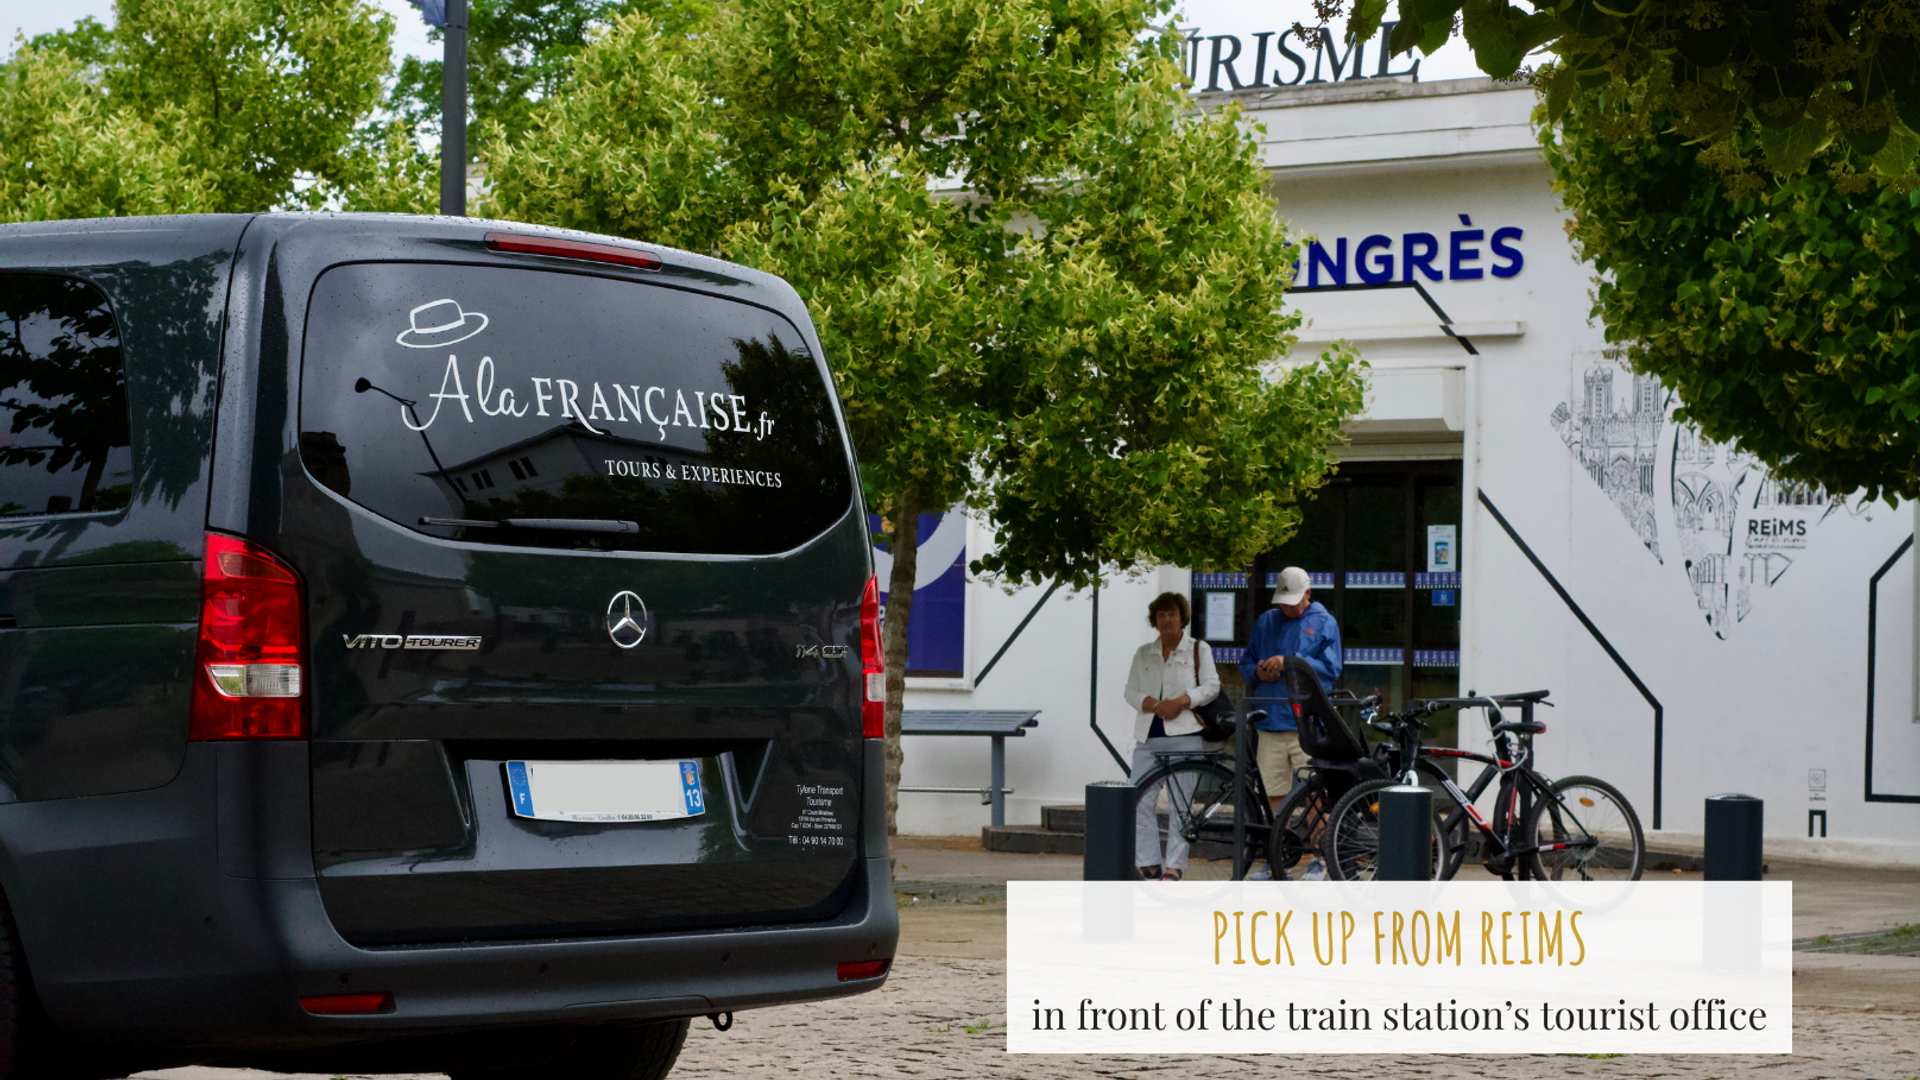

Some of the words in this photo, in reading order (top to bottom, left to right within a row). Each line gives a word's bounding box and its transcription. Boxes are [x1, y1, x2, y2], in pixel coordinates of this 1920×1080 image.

[1281, 213, 1524, 287] NGRÈS
[604, 459, 661, 480] TOURS
[665, 464, 677, 481] &
[681, 464, 783, 488] EXPERIENCES
[342, 633, 403, 650] VITO
[406, 637, 480, 649] TOURER
[686, 788, 702, 807] 13
[817, 785, 843, 796] Transport
[519, 793, 526, 805] F
[806, 796, 832, 806] Tourisme
[802, 835, 810, 845] 04
[810, 836, 819, 845] 90
